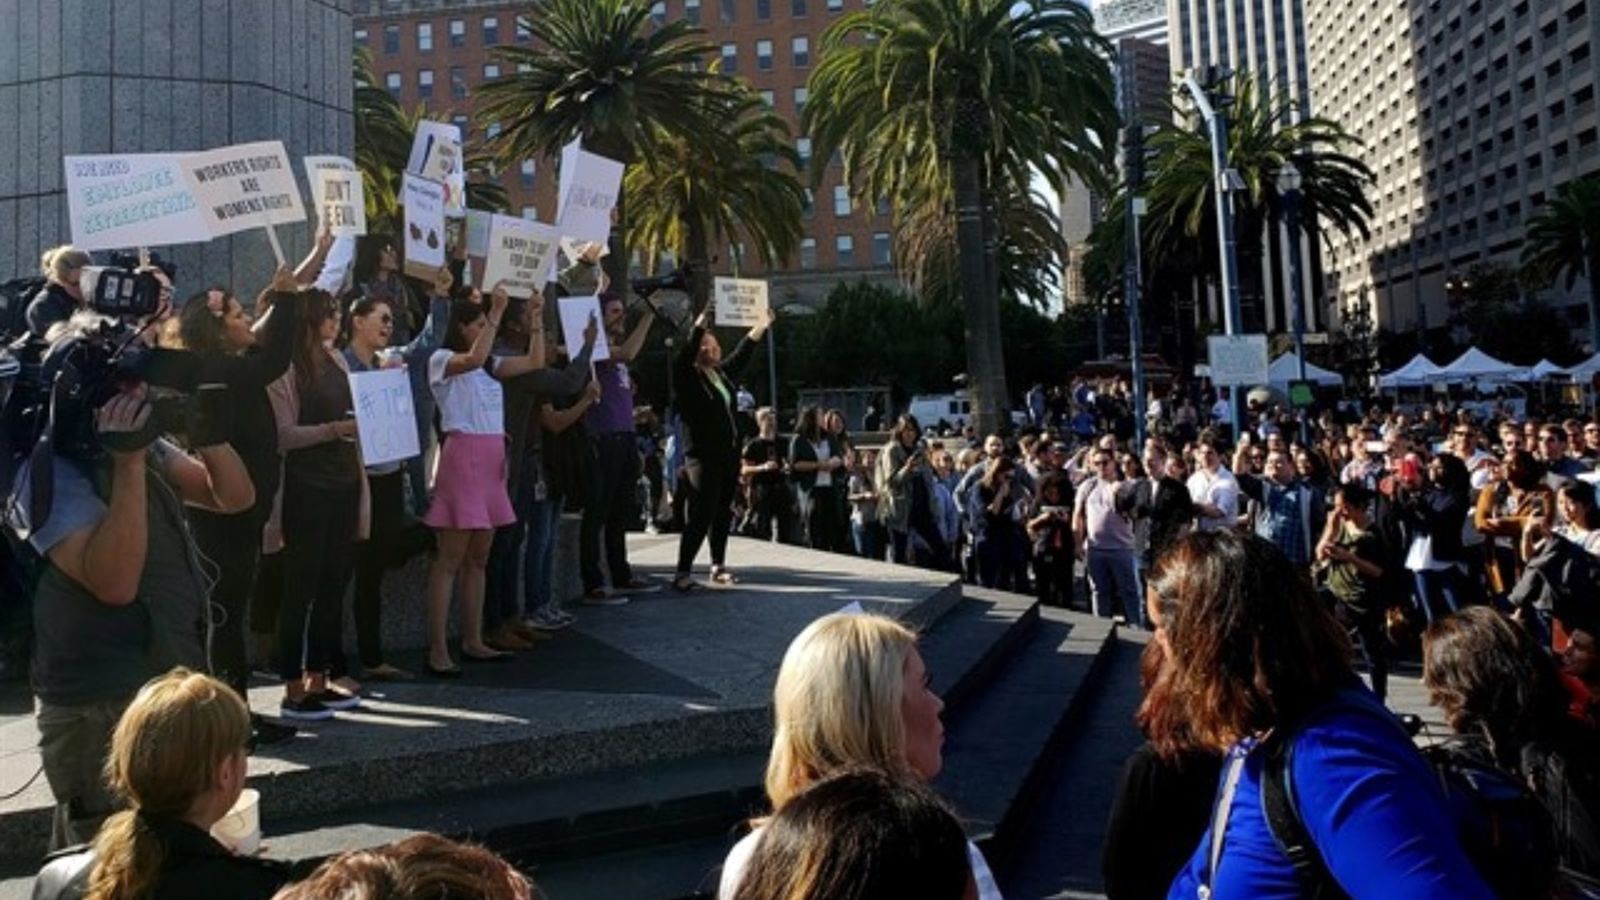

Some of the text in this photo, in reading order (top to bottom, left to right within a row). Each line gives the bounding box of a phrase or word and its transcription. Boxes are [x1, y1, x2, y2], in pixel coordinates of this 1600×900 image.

[193, 154, 283, 183] WORKERS RIGHTS
[240, 177, 261, 193] ARE
[212, 192, 293, 221] WOMENS RIGHTS
